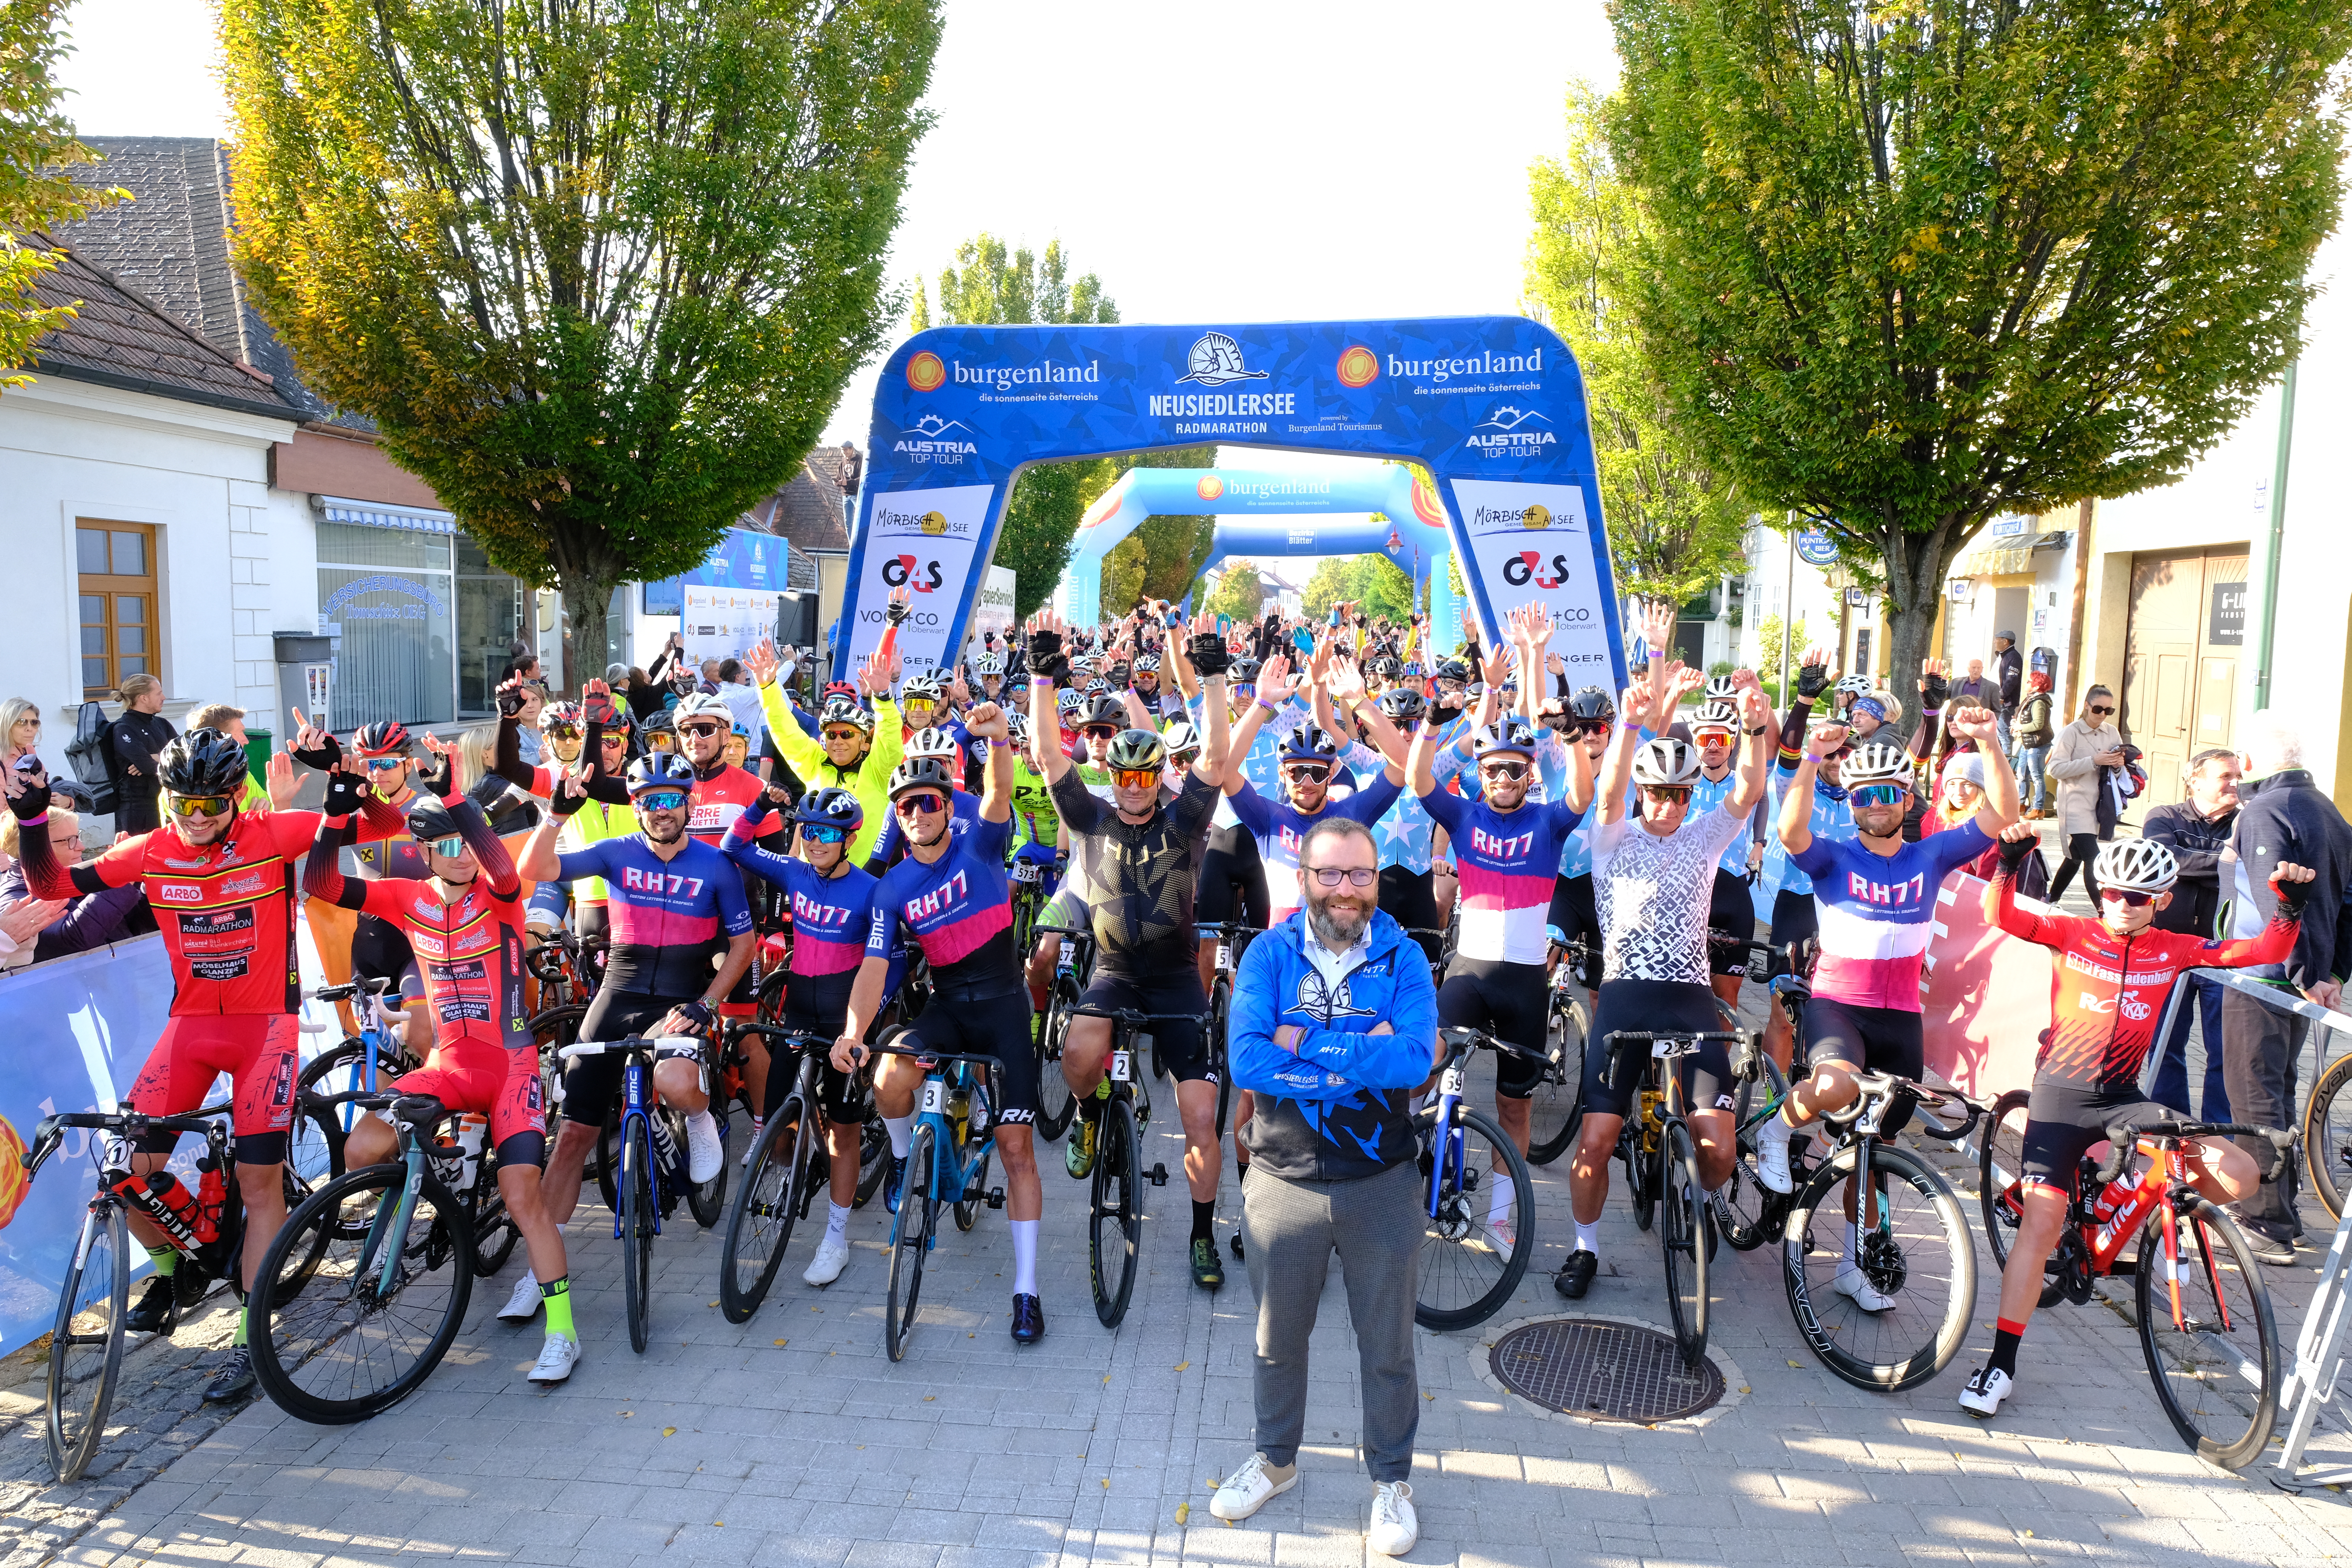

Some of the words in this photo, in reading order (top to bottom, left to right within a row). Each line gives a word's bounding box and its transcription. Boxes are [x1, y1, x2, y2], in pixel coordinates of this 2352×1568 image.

[1388, 348, 1542, 381] burgenland
[954, 360, 1099, 390] burgenland
[1430, 385, 1486, 394] sonnenseite
[1488, 381, 1540, 392] österreichs
[995, 394, 1047, 402] sonnenseite
[1049, 392, 1098, 401] österreichs
[1150, 394, 1295, 416] NEUSIEDLERSEE
[1176, 422, 1267, 434] RADMARATHON
[1288, 423, 1335, 433] Burgenland
[1338, 422, 1382, 431] Tourismus
[894, 441, 977, 454] AUSTRIA
[1466, 432, 1556, 447] AUSTRIA
[909, 453, 930, 464] TOP
[933, 454, 963, 464] TOUR
[1482, 447, 1506, 458] TOP
[1509, 446, 1540, 457] TOUR
[1230, 479, 1331, 499] burgenland
[876, 508, 934, 526] MÖRBISCH
[939, 521, 951, 533] AM
[952, 522, 968, 532] SEE
[1474, 505, 1537, 527] MÖRBISCH
[1543, 514, 1557, 526] AM
[1559, 514, 1574, 525] SEE
[1289, 536, 1313, 545] Blätter
[710, 557, 729, 567] AUSTRIA
[1503, 551, 1569, 589] G4S
[881, 554, 942, 593] G4S
[322, 575, 444, 617] VERSICHERUNGSBÜRO
[981, 586, 1014, 608] apierService
[345, 602, 400, 619] Tomschitz
[402, 603, 426, 620] OEG
[860, 610, 938, 626] VO+CO
[911, 626, 945, 634] Oberwart
[857, 655, 934, 666] HIGER
[691, 807, 720, 818] ERRE
[688, 818, 720, 826] GUETTE
[873, 820, 890, 854] BMC
[1473, 827, 1533, 857] RH77
[755, 847, 792, 864] BMC
[624, 867, 703, 897] RH77
[1018, 868, 1035, 880] 573
[164, 887, 200, 900] ARBÖ
[906, 868, 967, 921] RH77
[1851, 871, 1923, 904] RH77
[794, 892, 851, 925] RH77
[183, 918, 252, 934] RADMARATHON
[213, 912, 234, 924] ARBÖ
[867, 906, 884, 950] BMC
[417, 934, 442, 952] ARBÖ
[2084, 942, 2099, 953] giga
[2100, 949, 2119, 959] sport
[193, 959, 246, 969] MÖBELHAUS
[1219, 952, 1226, 964] 5
[201, 966, 239, 975] GLANZER
[431, 970, 484, 980] RADMARATHON
[1357, 965, 1387, 974] H77
[440, 1004, 487, 1013] MÖBELHAUS
[2124, 1005, 2149, 1018] KAC
[1319, 1046, 1348, 1056] RH77
[1117, 1059, 1125, 1076] 2
[282, 1056, 295, 1104] RADMARATHON
[925, 1090, 934, 1106] 3
[2173, 1154, 2183, 1180] BMC
[2095, 1199, 2138, 1255] BMC
